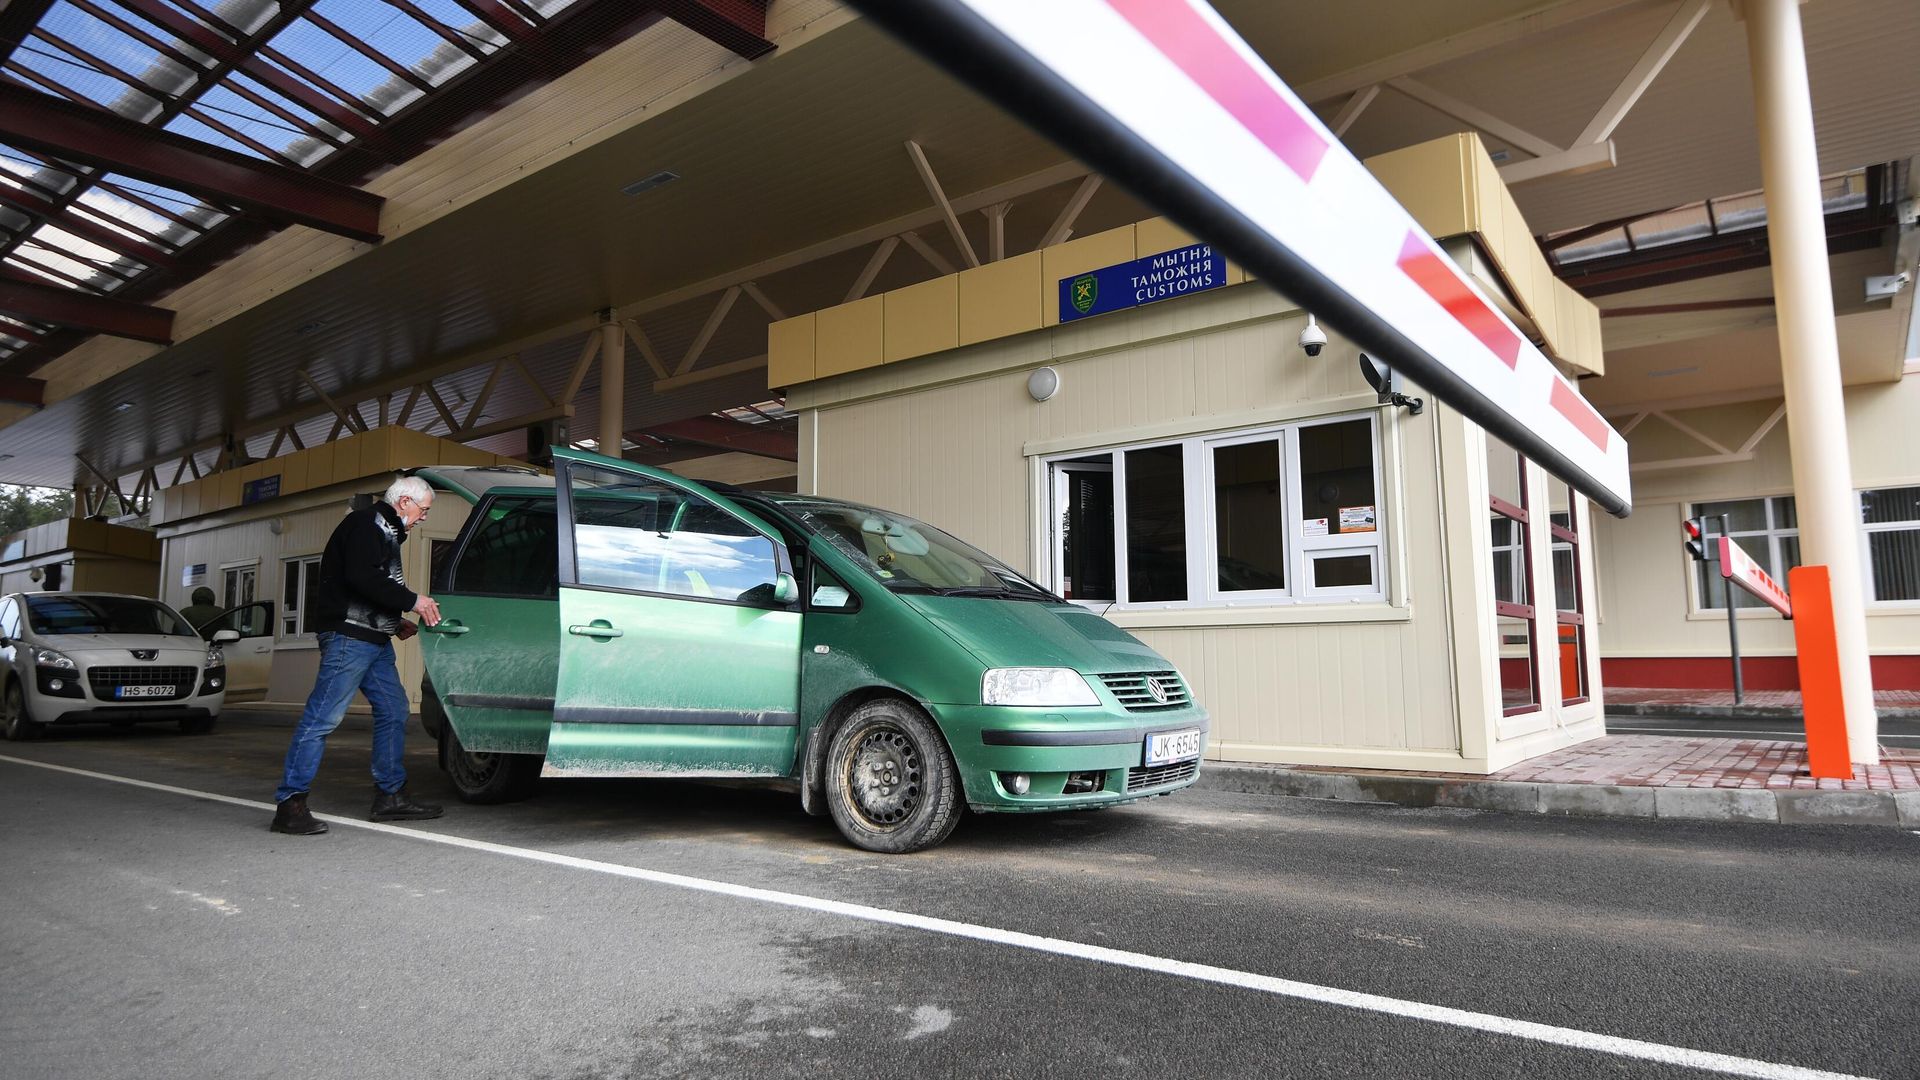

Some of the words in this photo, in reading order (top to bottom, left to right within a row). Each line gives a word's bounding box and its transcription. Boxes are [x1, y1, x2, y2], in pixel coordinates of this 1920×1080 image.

[1152, 246, 1212, 270] МЫТНЯ
[1131, 260, 1212, 288] ТАМОЖНЯ
[1136, 274, 1212, 301] CUSTOMS
